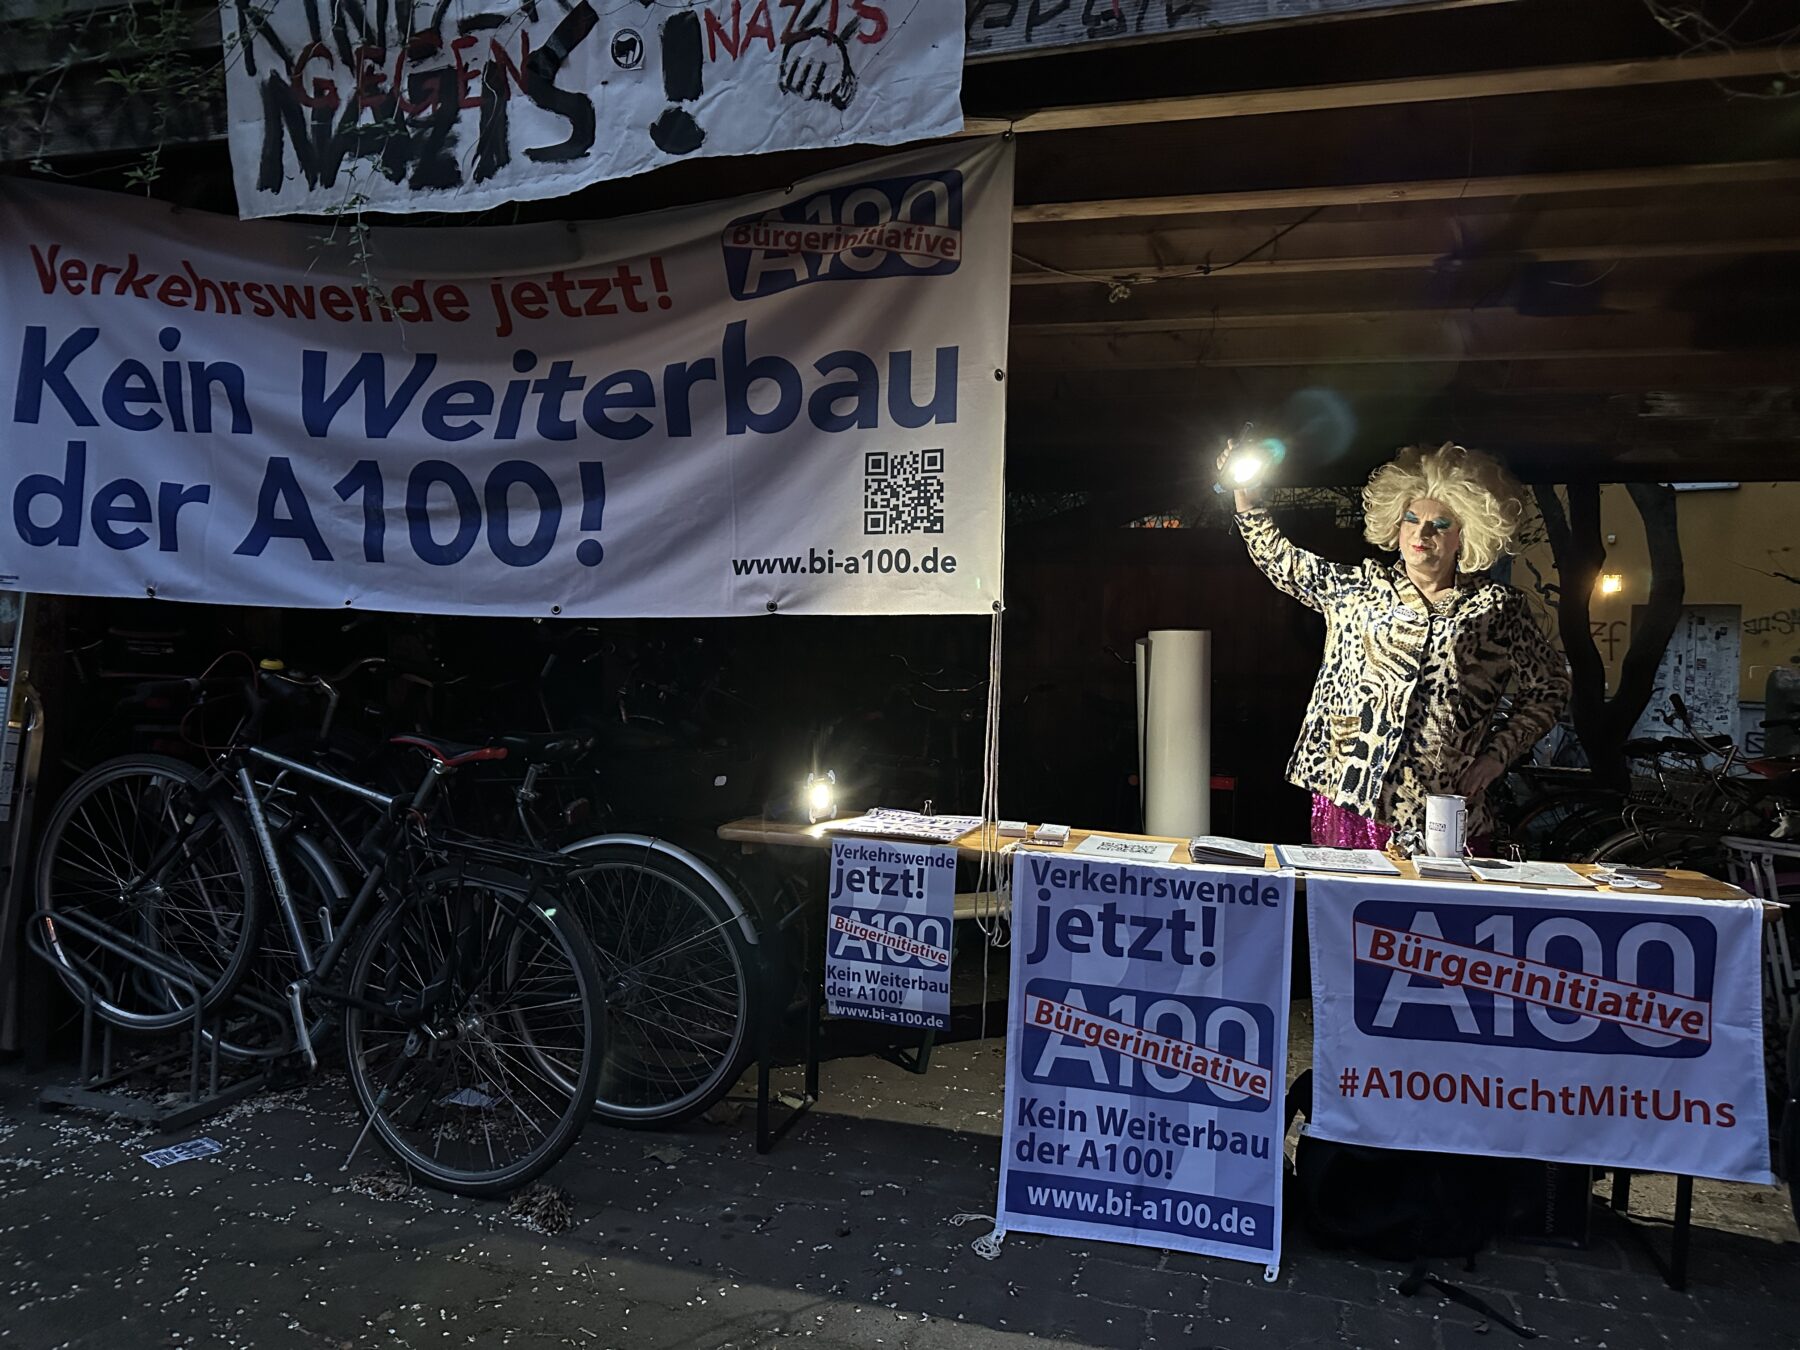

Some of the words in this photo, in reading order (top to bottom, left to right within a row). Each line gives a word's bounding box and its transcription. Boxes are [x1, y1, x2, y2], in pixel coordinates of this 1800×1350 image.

[732, 221, 958, 258] Bürgerinitiative
[30, 244, 471, 323] Verkehrswende
[491, 257, 672, 337] jetzt!
[13, 325, 253, 434] Kein
[302, 320, 959, 441] Weiterbau
[13, 441, 211, 552] der
[233, 456, 606, 567] A100!
[733, 548, 957, 576] www.bi-a100.de
[831, 859, 925, 900] jetzt!
[834, 843, 956, 869] Verkehrswende
[1031, 859, 1279, 908] Verkehrswende
[835, 910, 945, 967] A100
[835, 916, 947, 963] Bürgerinitiative
[1027, 888, 1217, 967] jetzt!
[827, 965, 861, 983] Kein
[865, 969, 949, 995] Weiterbau
[827, 982, 853, 998] der
[857, 986, 903, 1004] A100!
[1370, 929, 1704, 1035] Bürgerinitiative
[1372, 911, 1695, 1048] A100
[836, 1006, 944, 1028] www.bi-a100.de
[1034, 988, 1260, 1101] A100
[1034, 999, 1268, 1096] Bürgerinitiative
[1339, 1066, 1736, 1128] #A100NichtMitUns
[1016, 1133, 1069, 1165] der
[1078, 1143, 1174, 1180] A100!
[1018, 1098, 1087, 1132] Kein
[1097, 1105, 1269, 1160] Weiterbau
[1028, 1185, 1257, 1238] www.bi-a100.de
